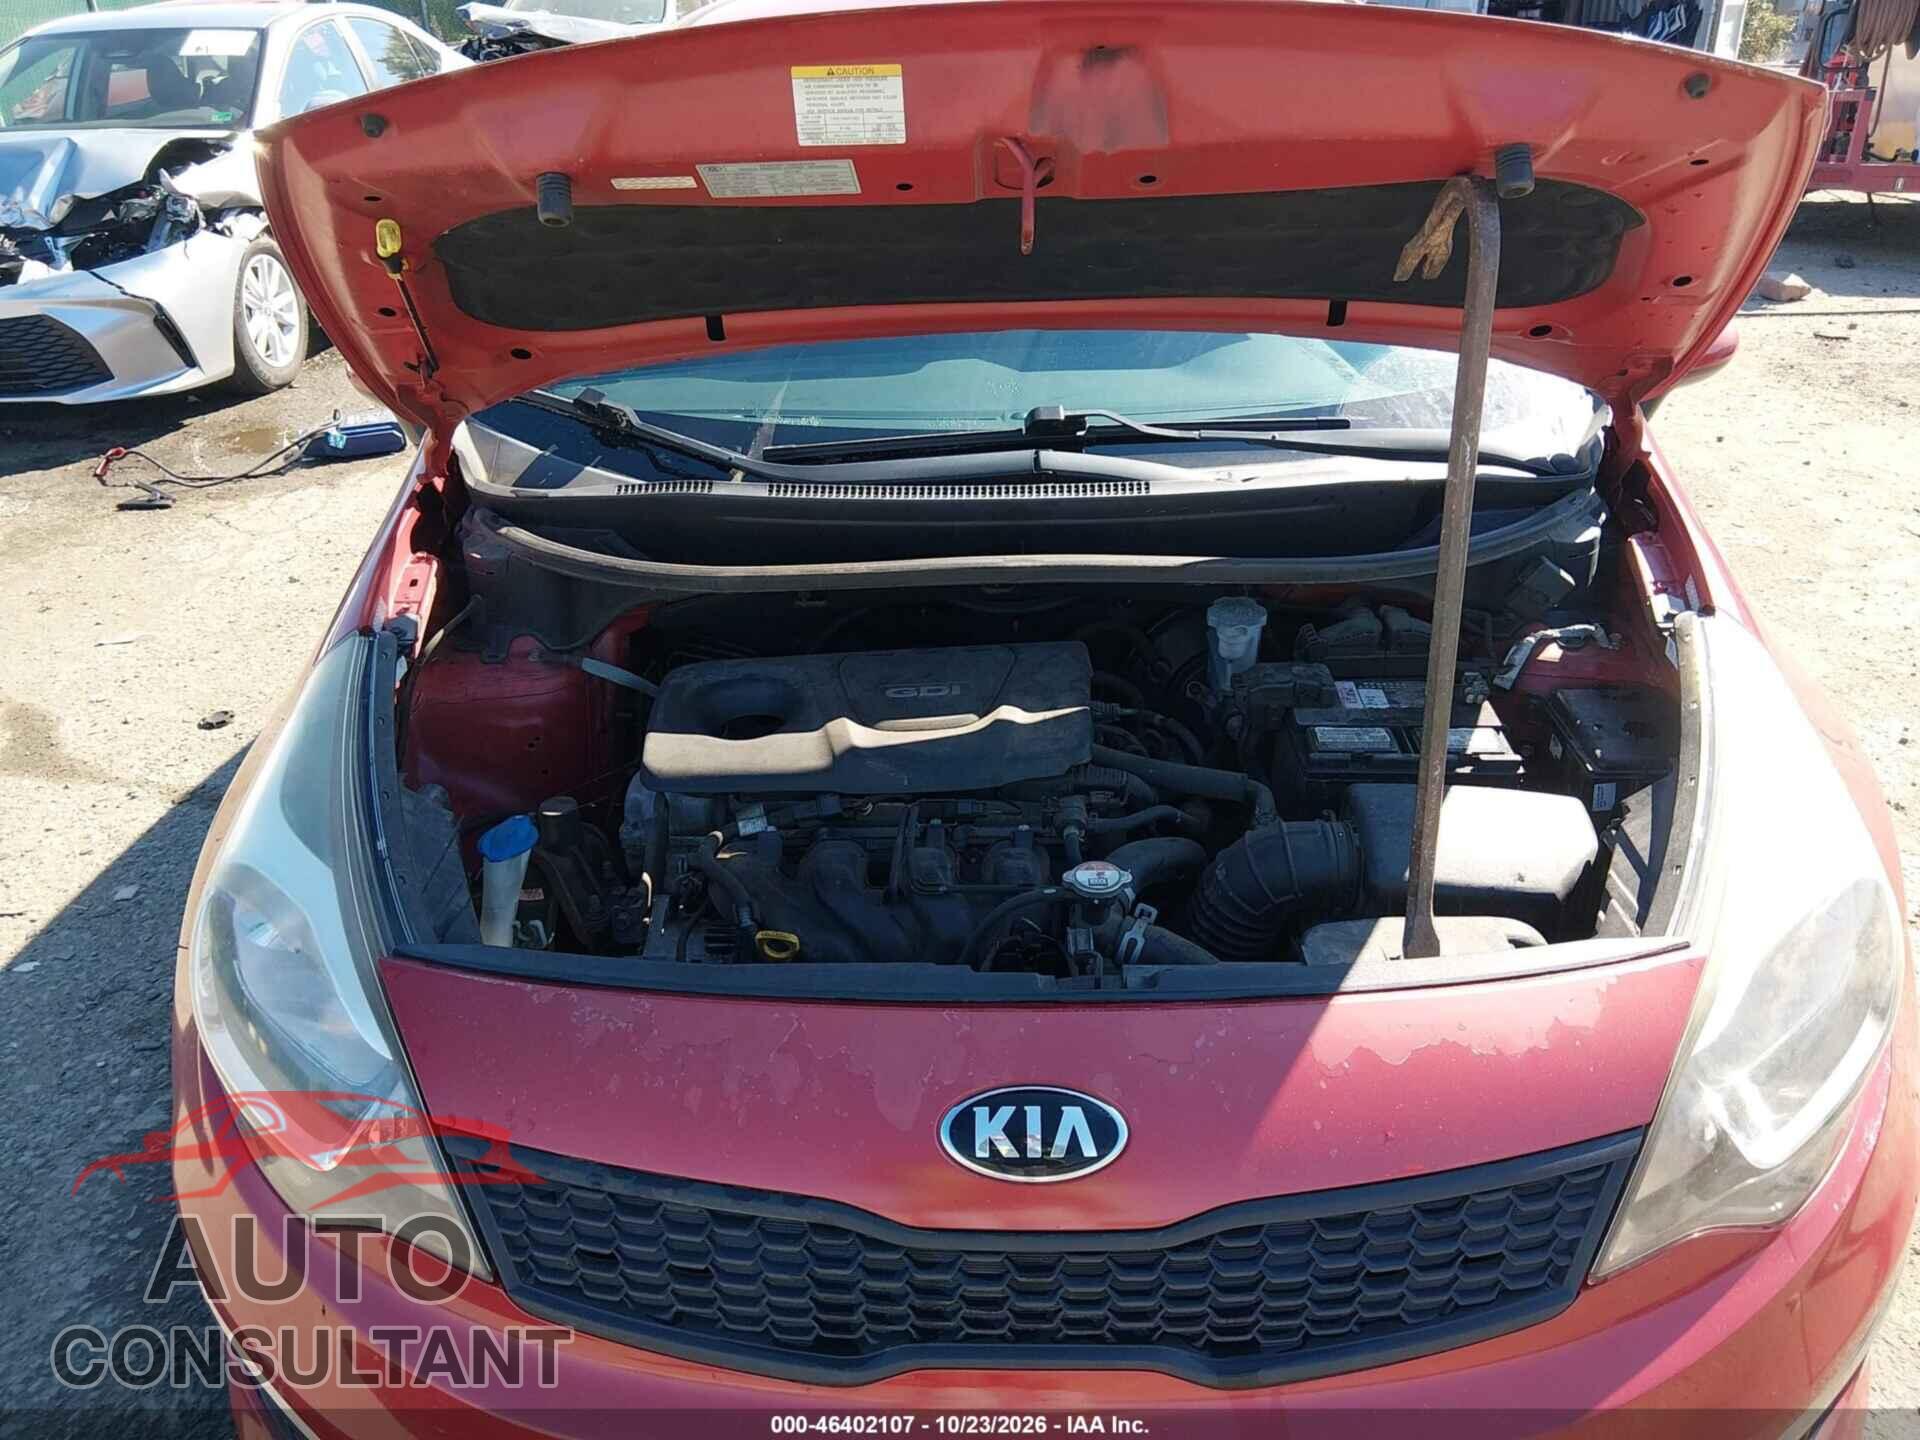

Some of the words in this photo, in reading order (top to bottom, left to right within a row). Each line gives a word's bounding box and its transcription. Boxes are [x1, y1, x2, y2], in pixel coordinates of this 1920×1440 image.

[835, 67, 874, 76] CAUTION
[886, 684, 961, 698] GDI
[973, 1106, 1098, 1158] KIA
